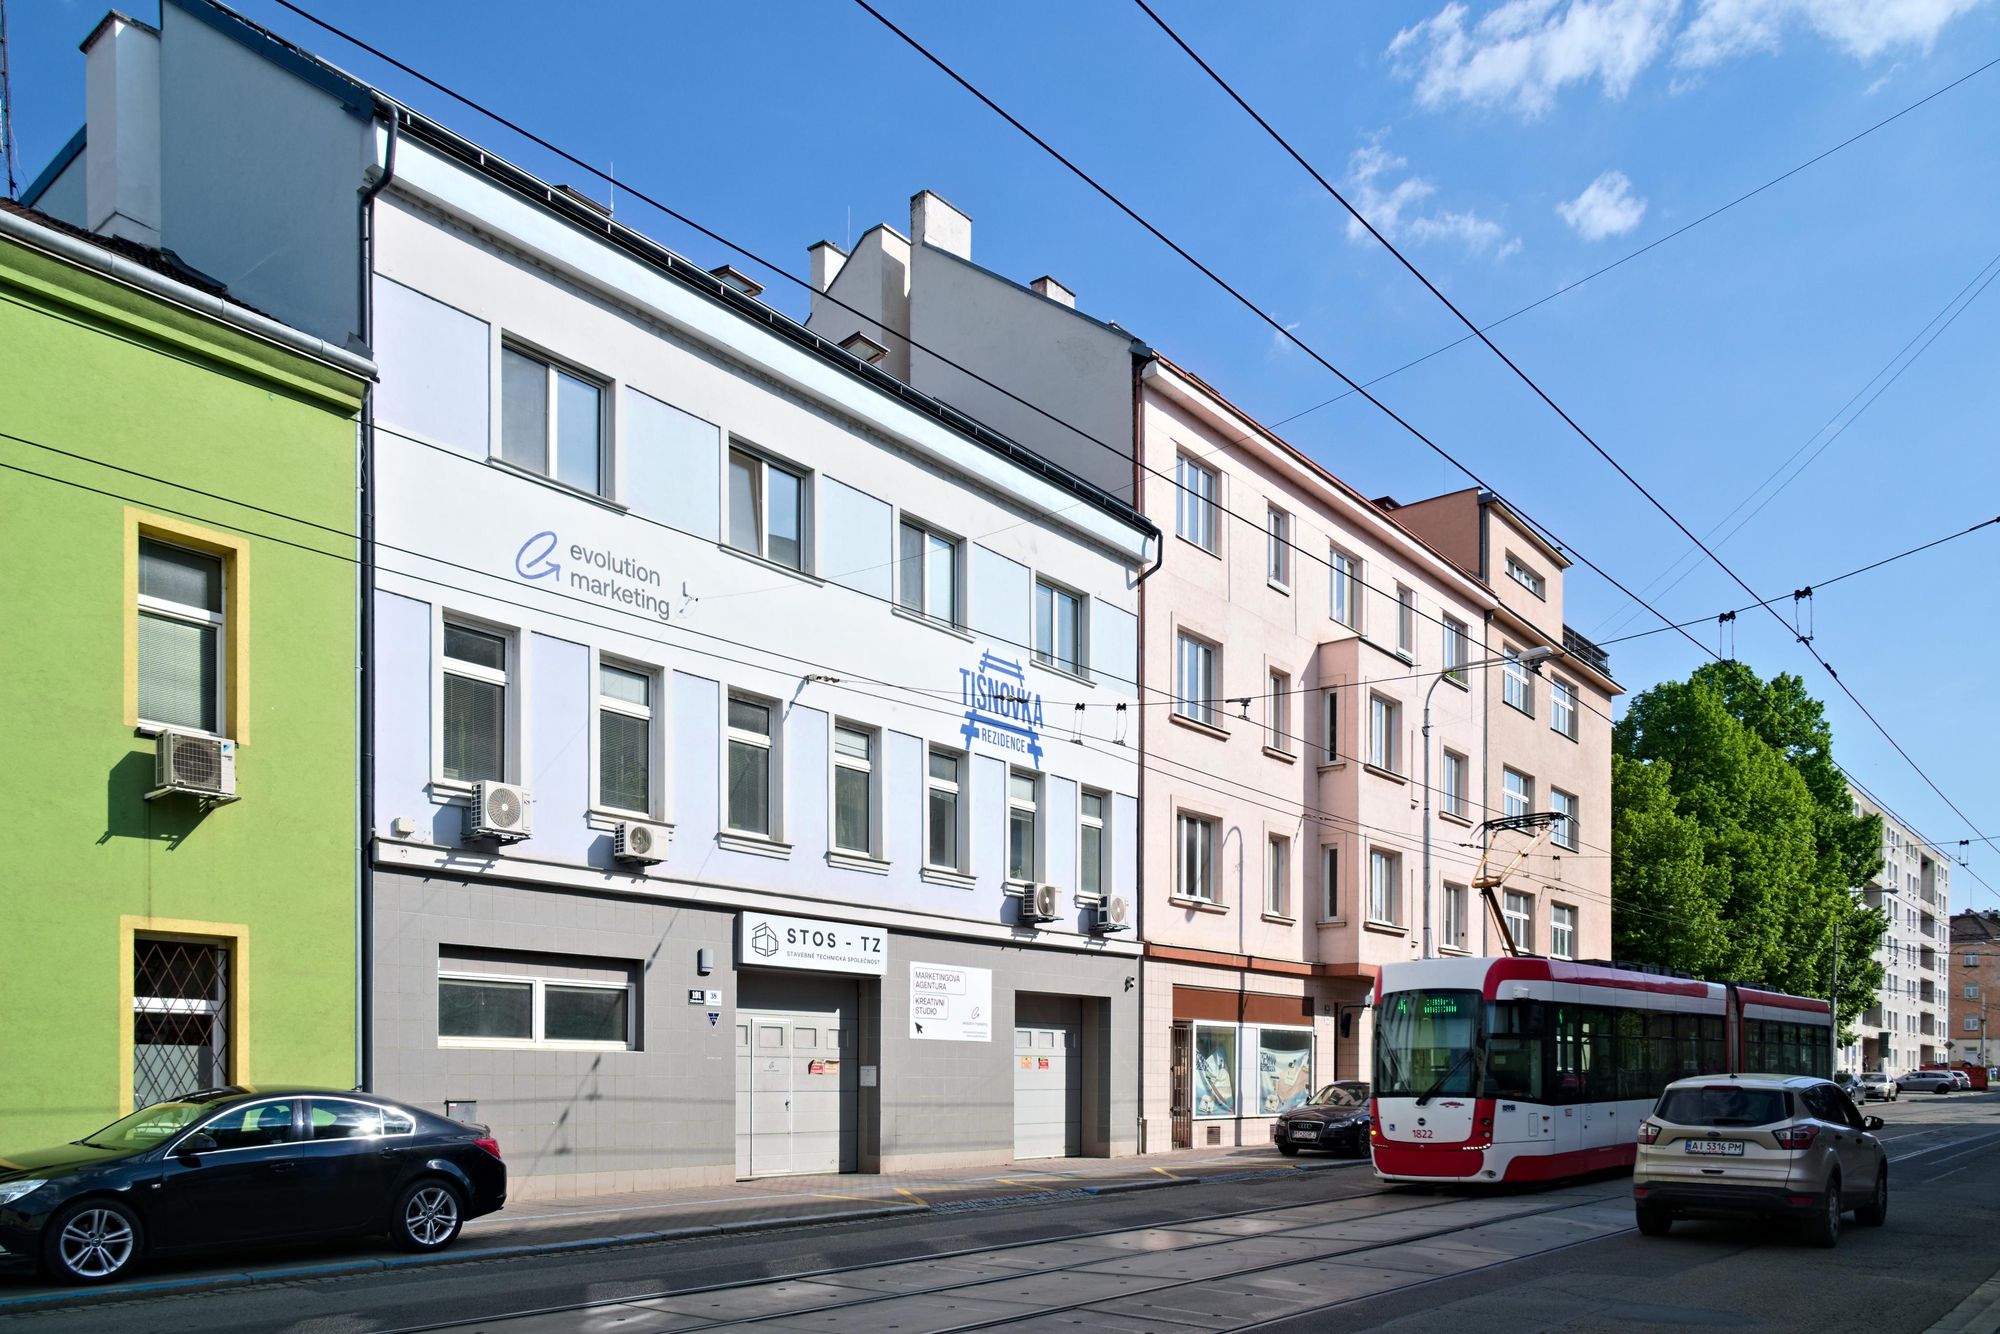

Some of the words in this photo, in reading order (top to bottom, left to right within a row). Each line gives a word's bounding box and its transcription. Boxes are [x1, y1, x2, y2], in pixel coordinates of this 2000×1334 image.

[570, 544, 660, 586] evolution
[570, 571, 670, 620] marketing
[959, 666, 1043, 728] TIŠNOVKA
[982, 728, 1026, 753] REZIDENCE
[787, 928, 836, 948] STOS
[861, 936, 881, 953] TZ
[915, 981, 947, 990] AGENTURA
[915, 1006, 937, 1015] STUDIO
[1412, 1129, 1433, 1139] 1822
[1692, 1142, 1703, 1150] AI
[1707, 1142, 1726, 1151] 5316
[1728, 1143, 1741, 1151] PM
